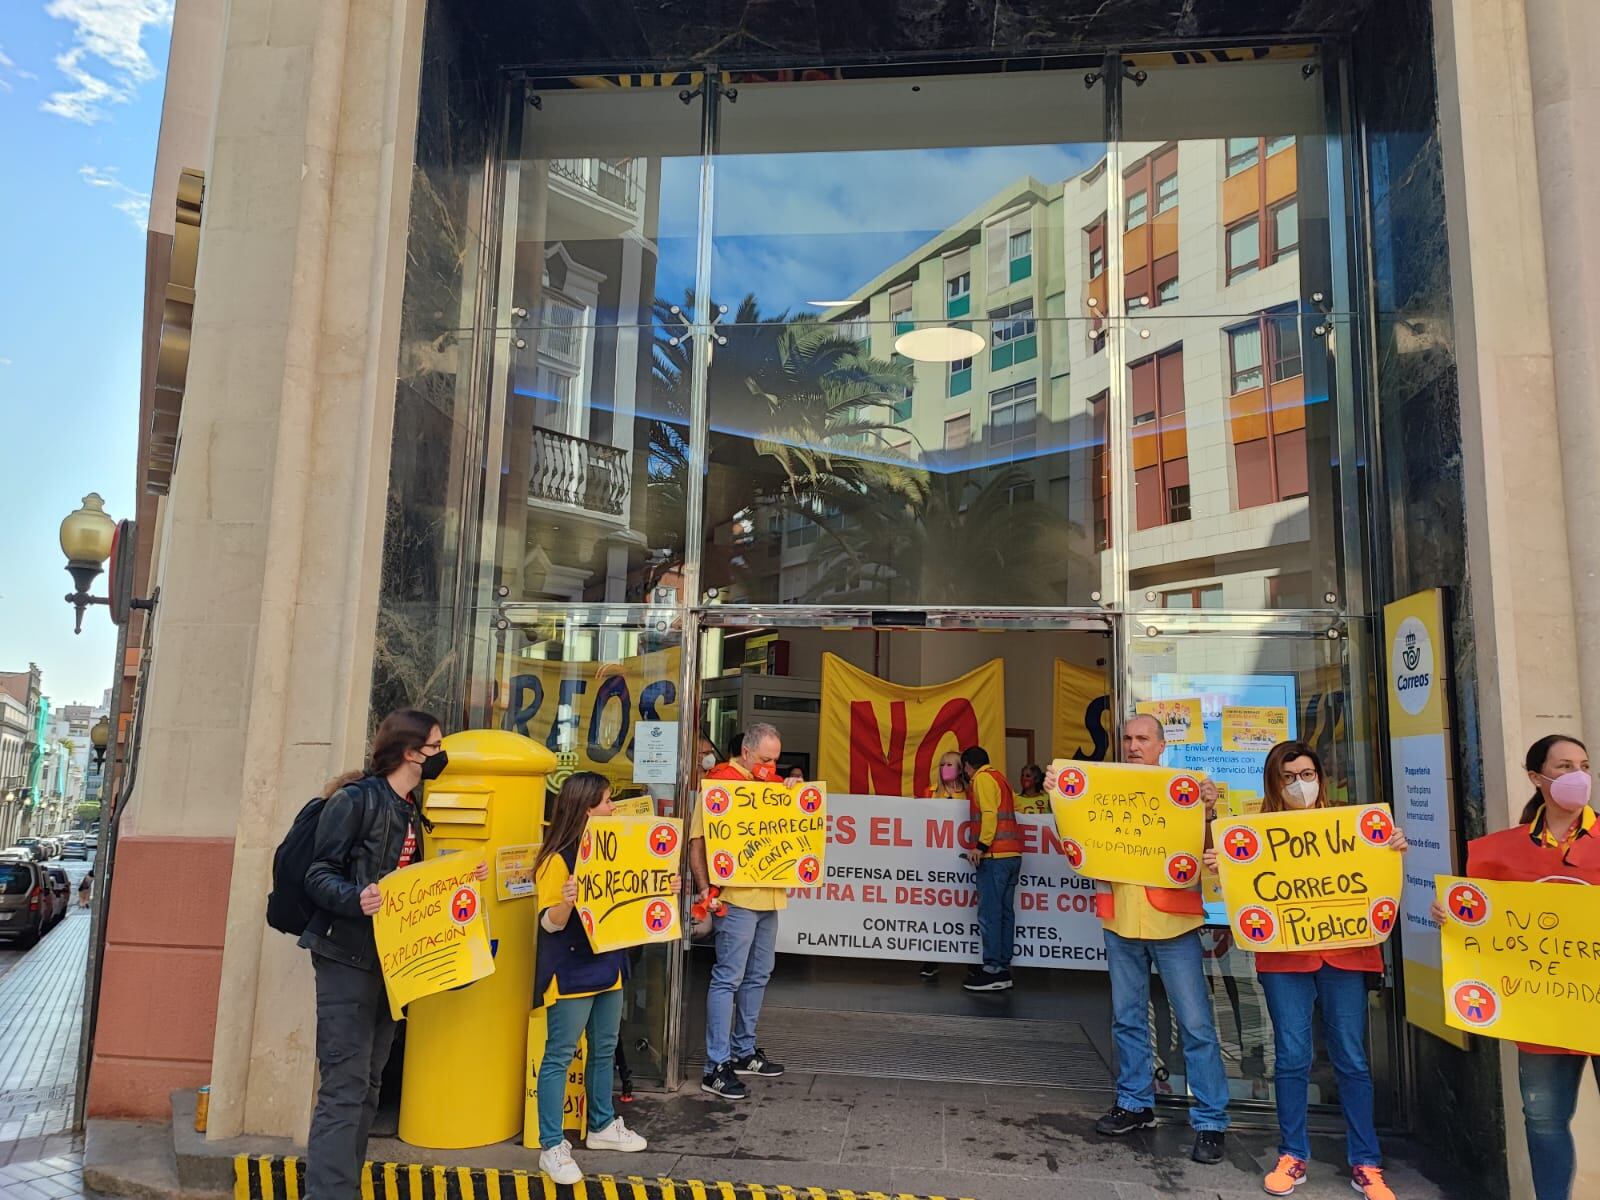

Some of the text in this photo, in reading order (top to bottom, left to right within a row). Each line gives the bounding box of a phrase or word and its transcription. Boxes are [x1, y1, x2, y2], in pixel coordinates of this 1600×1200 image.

[1397, 673, 1429, 692] Correos
[494, 674, 677, 763] REOS
[850, 697, 979, 798] NO
[762, 788, 792, 807] ESTO
[1093, 791, 1160, 811] REPARTO
[1122, 811, 1132, 823] A
[708, 820, 731, 840] NO
[869, 816, 912, 847] EL
[596, 830, 617, 862] NO
[1266, 828, 1320, 861] POR
[827, 866, 892, 881] DEFENSA
[896, 869, 924, 882] DEL
[576, 870, 603, 903] MÁS
[1253, 871, 1368, 902] CORREOS
[862, 885, 887, 903] EL
[1021, 892, 1049, 911] DE
[399, 900, 442, 933] MENOS
[863, 918, 928, 934] CONTRA
[933, 921, 965, 936] LOS
[1505, 910, 1560, 930] NO
[797, 932, 882, 949] PLANTILLA
[886, 937, 979, 954] SUFICIENTE
[1012, 943, 1034, 957] ON
[1464, 936, 1481, 954] A
[1492, 935, 1529, 952] LOS
[1529, 959, 1560, 975] DE
